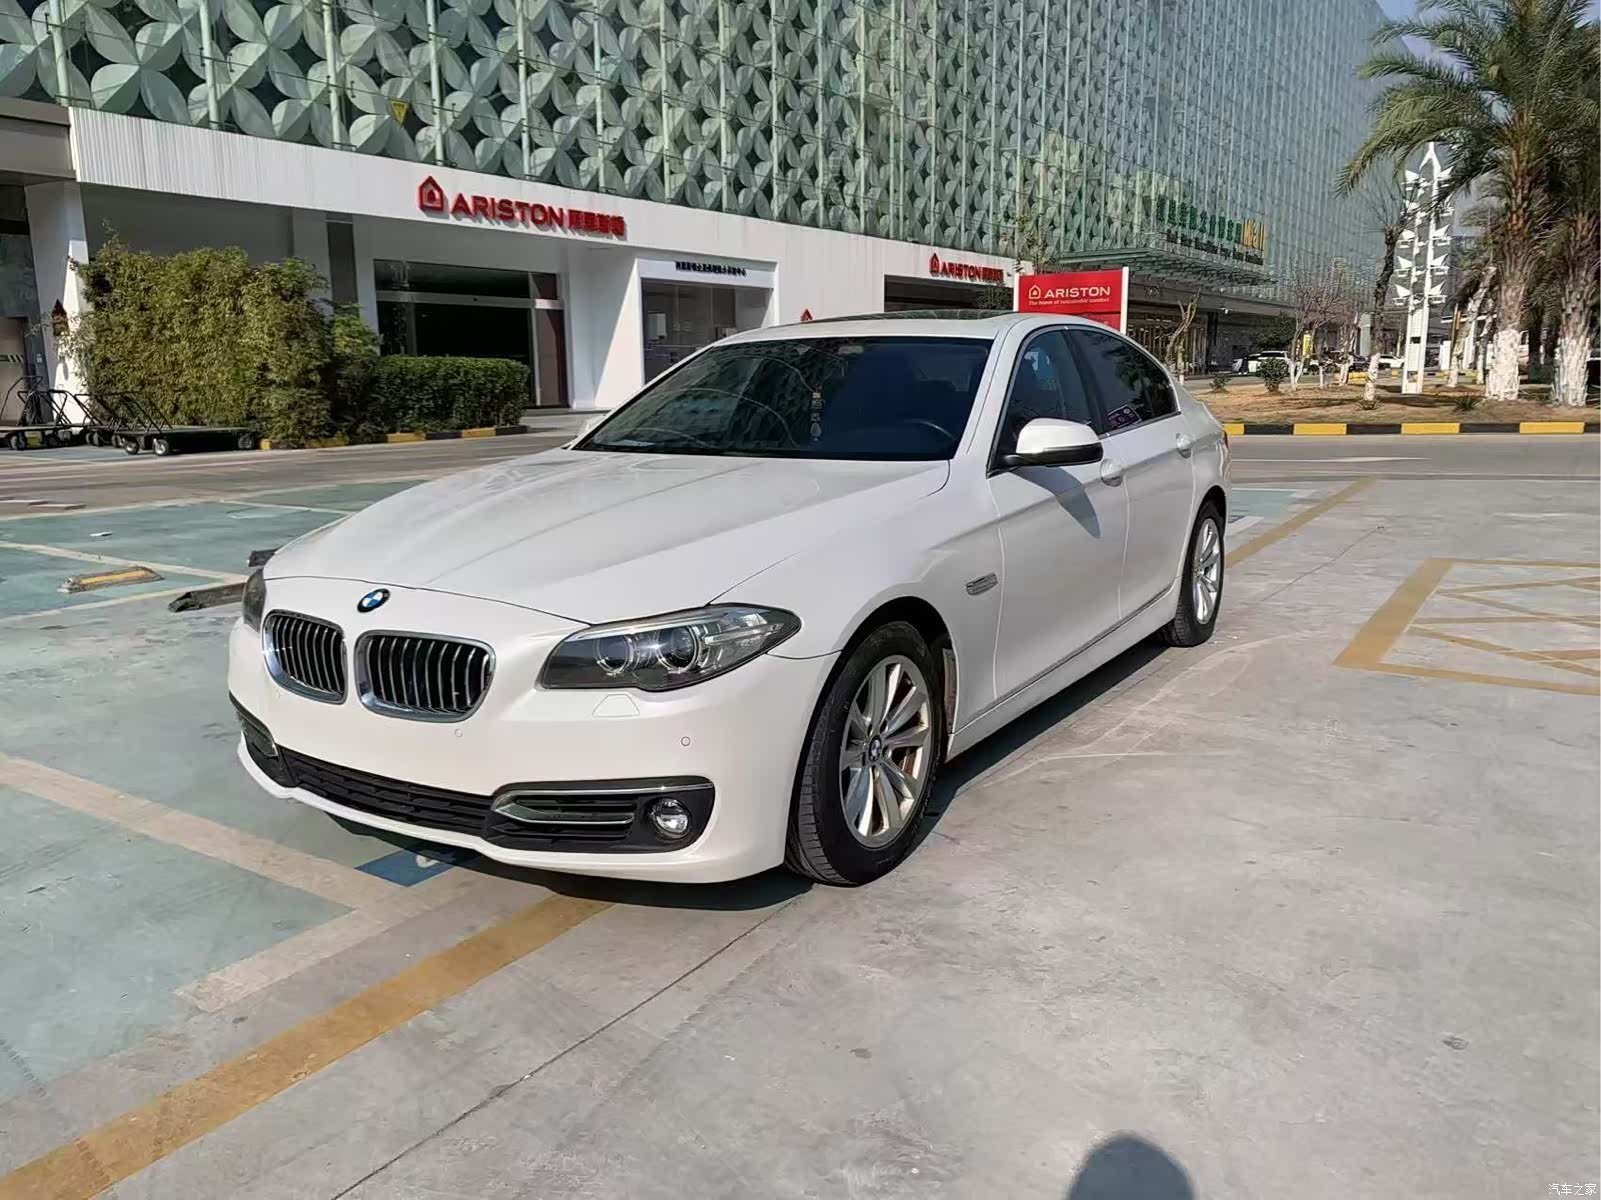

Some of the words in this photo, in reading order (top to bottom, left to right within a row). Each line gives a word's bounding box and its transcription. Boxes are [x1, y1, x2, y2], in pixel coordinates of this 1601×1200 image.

[451, 193, 563, 226] ARISTON
[941, 262, 981, 279] ARISTON
[1044, 286, 1111, 299] ARISTON
